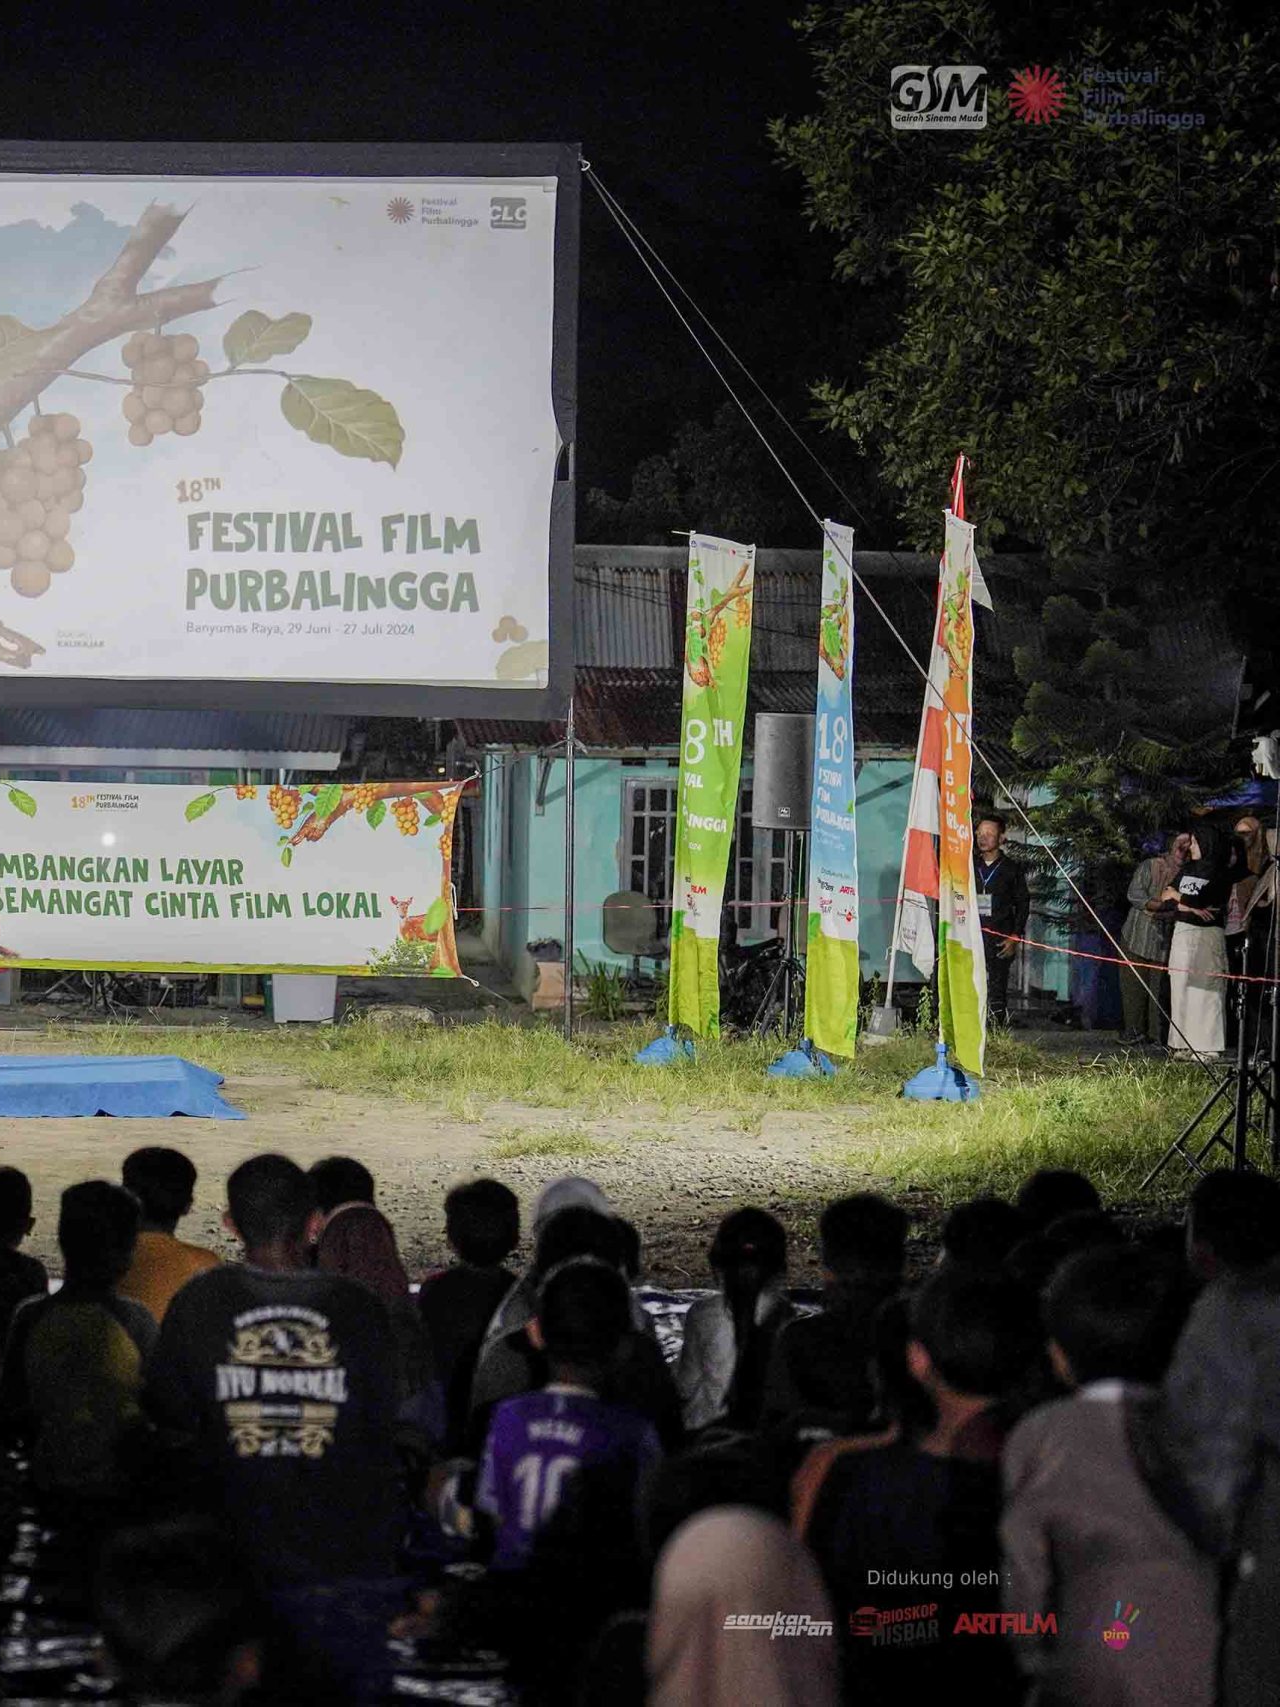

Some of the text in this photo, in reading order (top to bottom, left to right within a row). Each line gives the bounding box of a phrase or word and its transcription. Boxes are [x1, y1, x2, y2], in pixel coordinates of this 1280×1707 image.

[175, 477, 221, 503] 18TH
[187, 511, 481, 555] FESTIVAL FILM
[186, 568, 480, 613] PURBALINGGA
[186, 622, 248, 636] Banyumas
[251, 623, 284, 639] Raya,
[288, 623, 303, 634] 29
[305, 623, 331, 635] Juni
[343, 623, 358, 635] 27
[361, 623, 382, 635] Juli
[386, 624, 415, 635] 2024
[684, 718, 735, 765] 8TH
[97, 793, 122, 801] FESTIVAL
[160, 856, 244, 886] LAYAR
[302, 891, 382, 919] LOKAL
